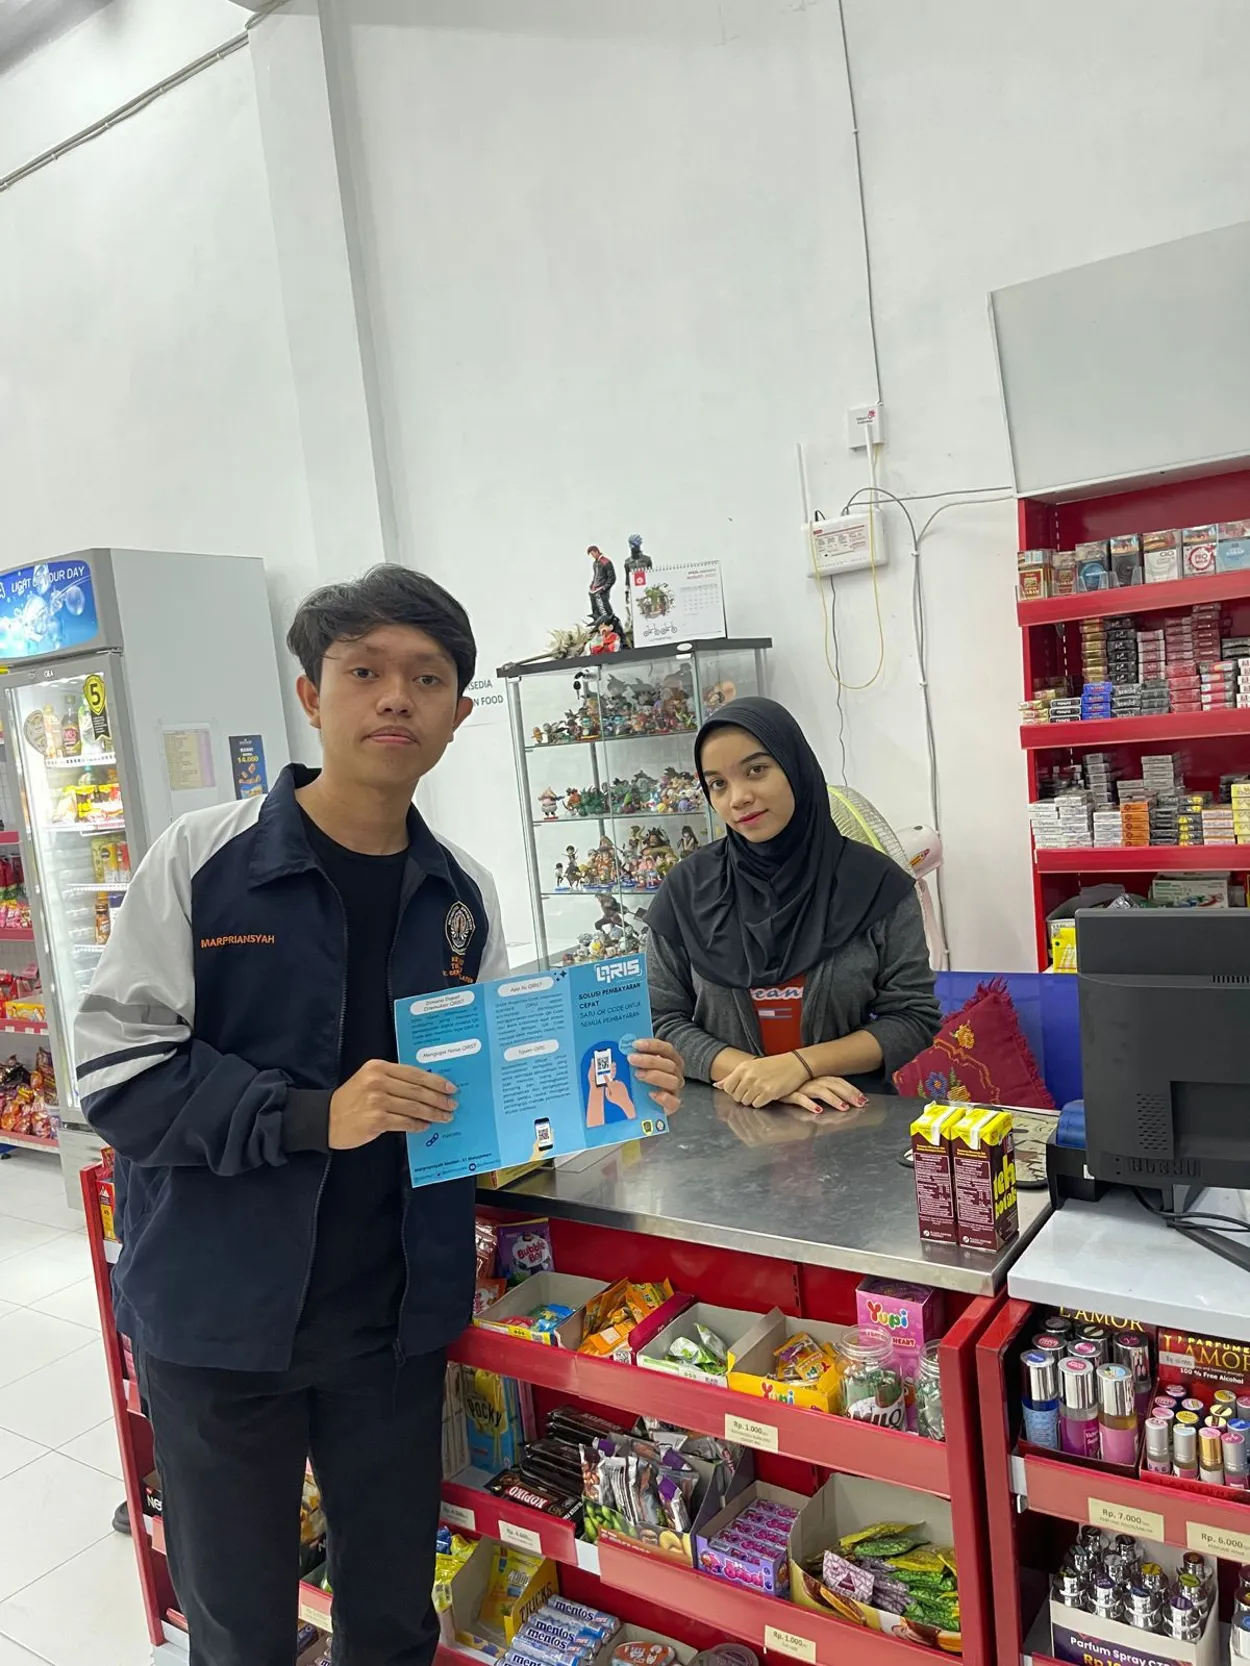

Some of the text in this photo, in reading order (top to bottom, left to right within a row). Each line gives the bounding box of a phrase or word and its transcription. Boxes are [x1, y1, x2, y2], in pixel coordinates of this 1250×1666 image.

[11, 577, 32, 593] LIGHT
[48, 570, 65, 584] OUR
[66, 566, 85, 579] DAY
[469, 679, 493, 690] SEDIA
[90, 682, 101, 706] 5
[481, 694, 504, 705] FOOD
[200, 934, 275, 948] MARPRIANSYAH
[596, 958, 640, 984] QRIS
[578, 982, 641, 1000] SOLUSI PEMBAYARAN
[579, 1000, 600, 1009] CEPAT
[579, 1011, 596, 1019] SATU
[607, 1005, 623, 1014] CODE
[580, 1011, 641, 1028] SEMUA PEMBAYARAN
[993, 1154, 1016, 1200] teh
[867, 1300, 909, 1329] Yupi
[892, 1337, 915, 1347] HEART
[1180, 1367, 1193, 1375] 100
[1203, 1371, 1218, 1380] Free
[1219, 1375, 1244, 1384] Alcohol
[734, 1421, 744, 1429] Rp.
[508, 1486, 548, 1509] KOPIKO
[1102, 1508, 1116, 1519] Rp.
[1201, 1533, 1216, 1542] Rp.
[555, 1600, 594, 1622] mentos
[527, 1628, 568, 1650] mentos
[536, 1620, 576, 1642] mentos
[773, 1631, 783, 1640] Rp.
[1070, 1636, 1111, 1657] Parfum
[1113, 1650, 1147, 1666] Spray
